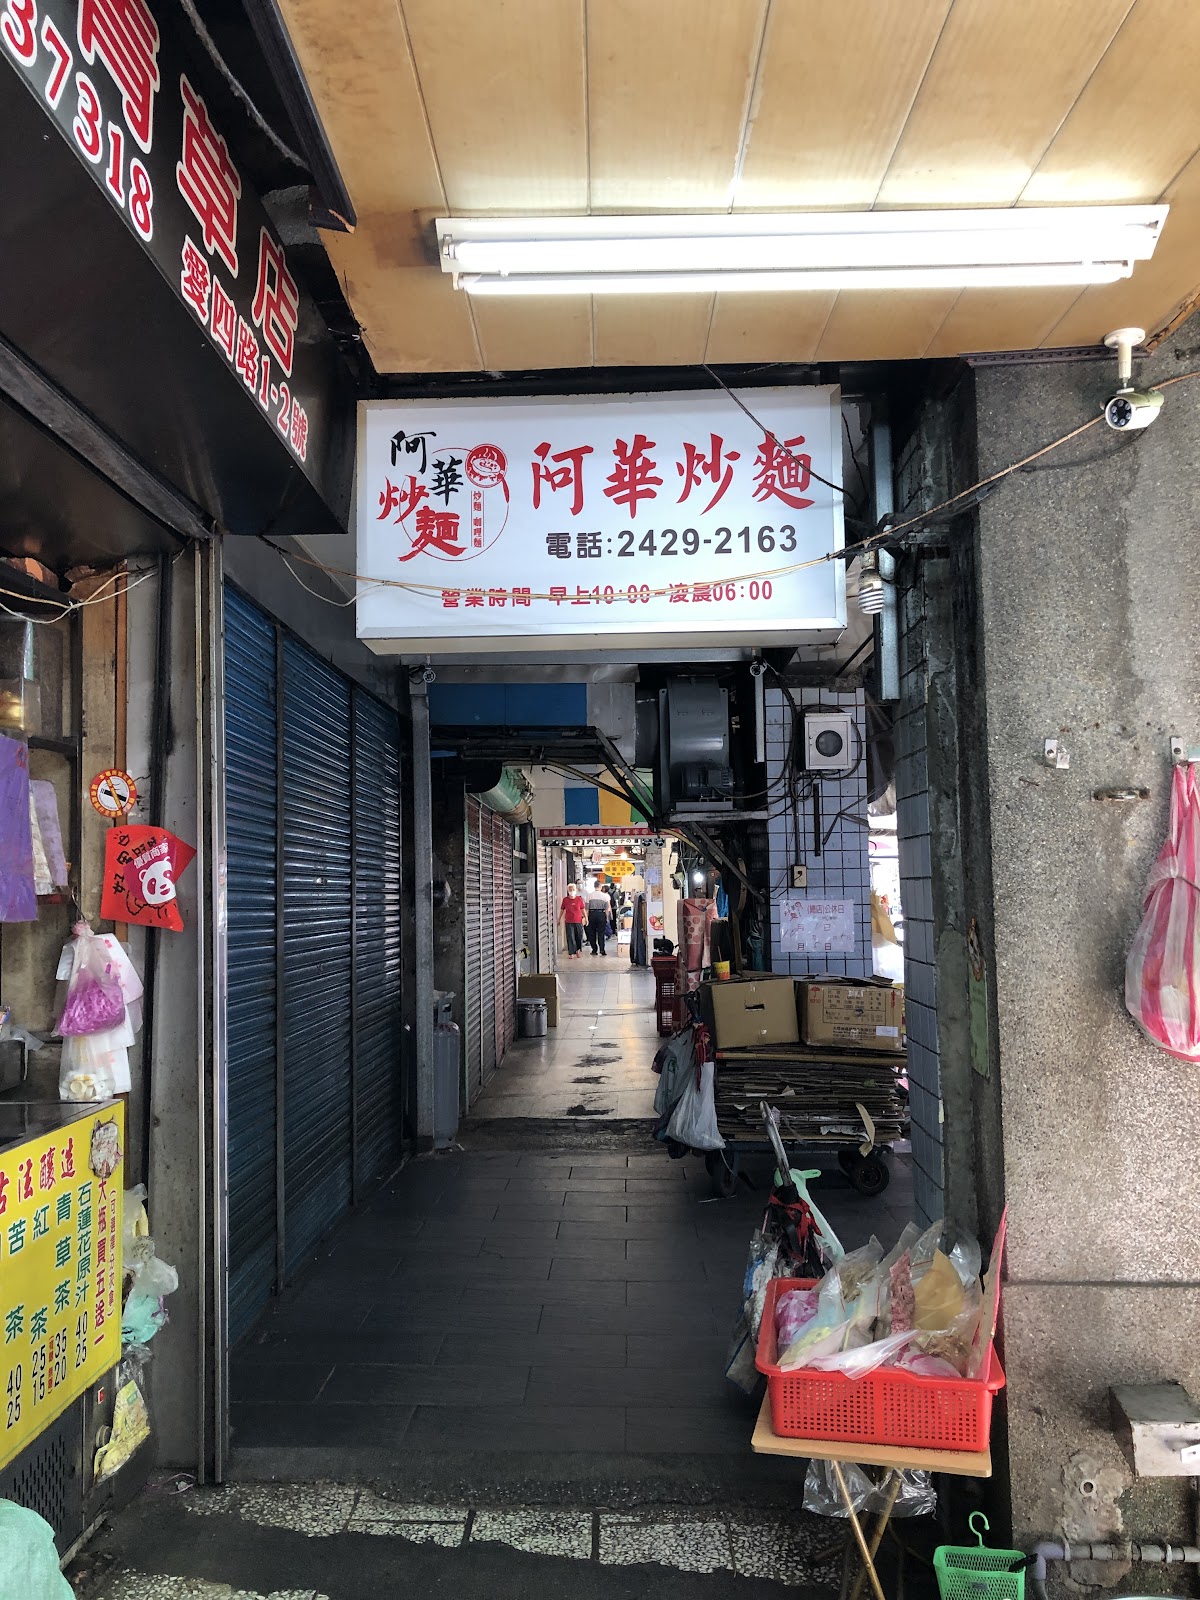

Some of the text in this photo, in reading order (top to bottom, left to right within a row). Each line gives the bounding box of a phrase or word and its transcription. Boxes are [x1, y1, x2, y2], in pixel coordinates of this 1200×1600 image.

[531, 432, 816, 519] 阿華炒麵
[546, 524, 798, 560] 電話:2429-2163
[441, 587, 531, 608] 營業時間
[133, 842, 169, 870] 優質商家
[55, 1192, 72, 1315] 青草茶
[75, 1181, 93, 1309] 石蓮花原汁
[75, 1311, 88, 1340] 40
[54, 1327, 67, 1359] 35
[75, 1338, 87, 1369] 25
[32, 1344, 46, 1378] 25
[54, 1356, 67, 1387] 20
[7, 1364, 22, 1397] 40
[33, 1373, 46, 1406] 15
[7, 1395, 21, 1429] 25
